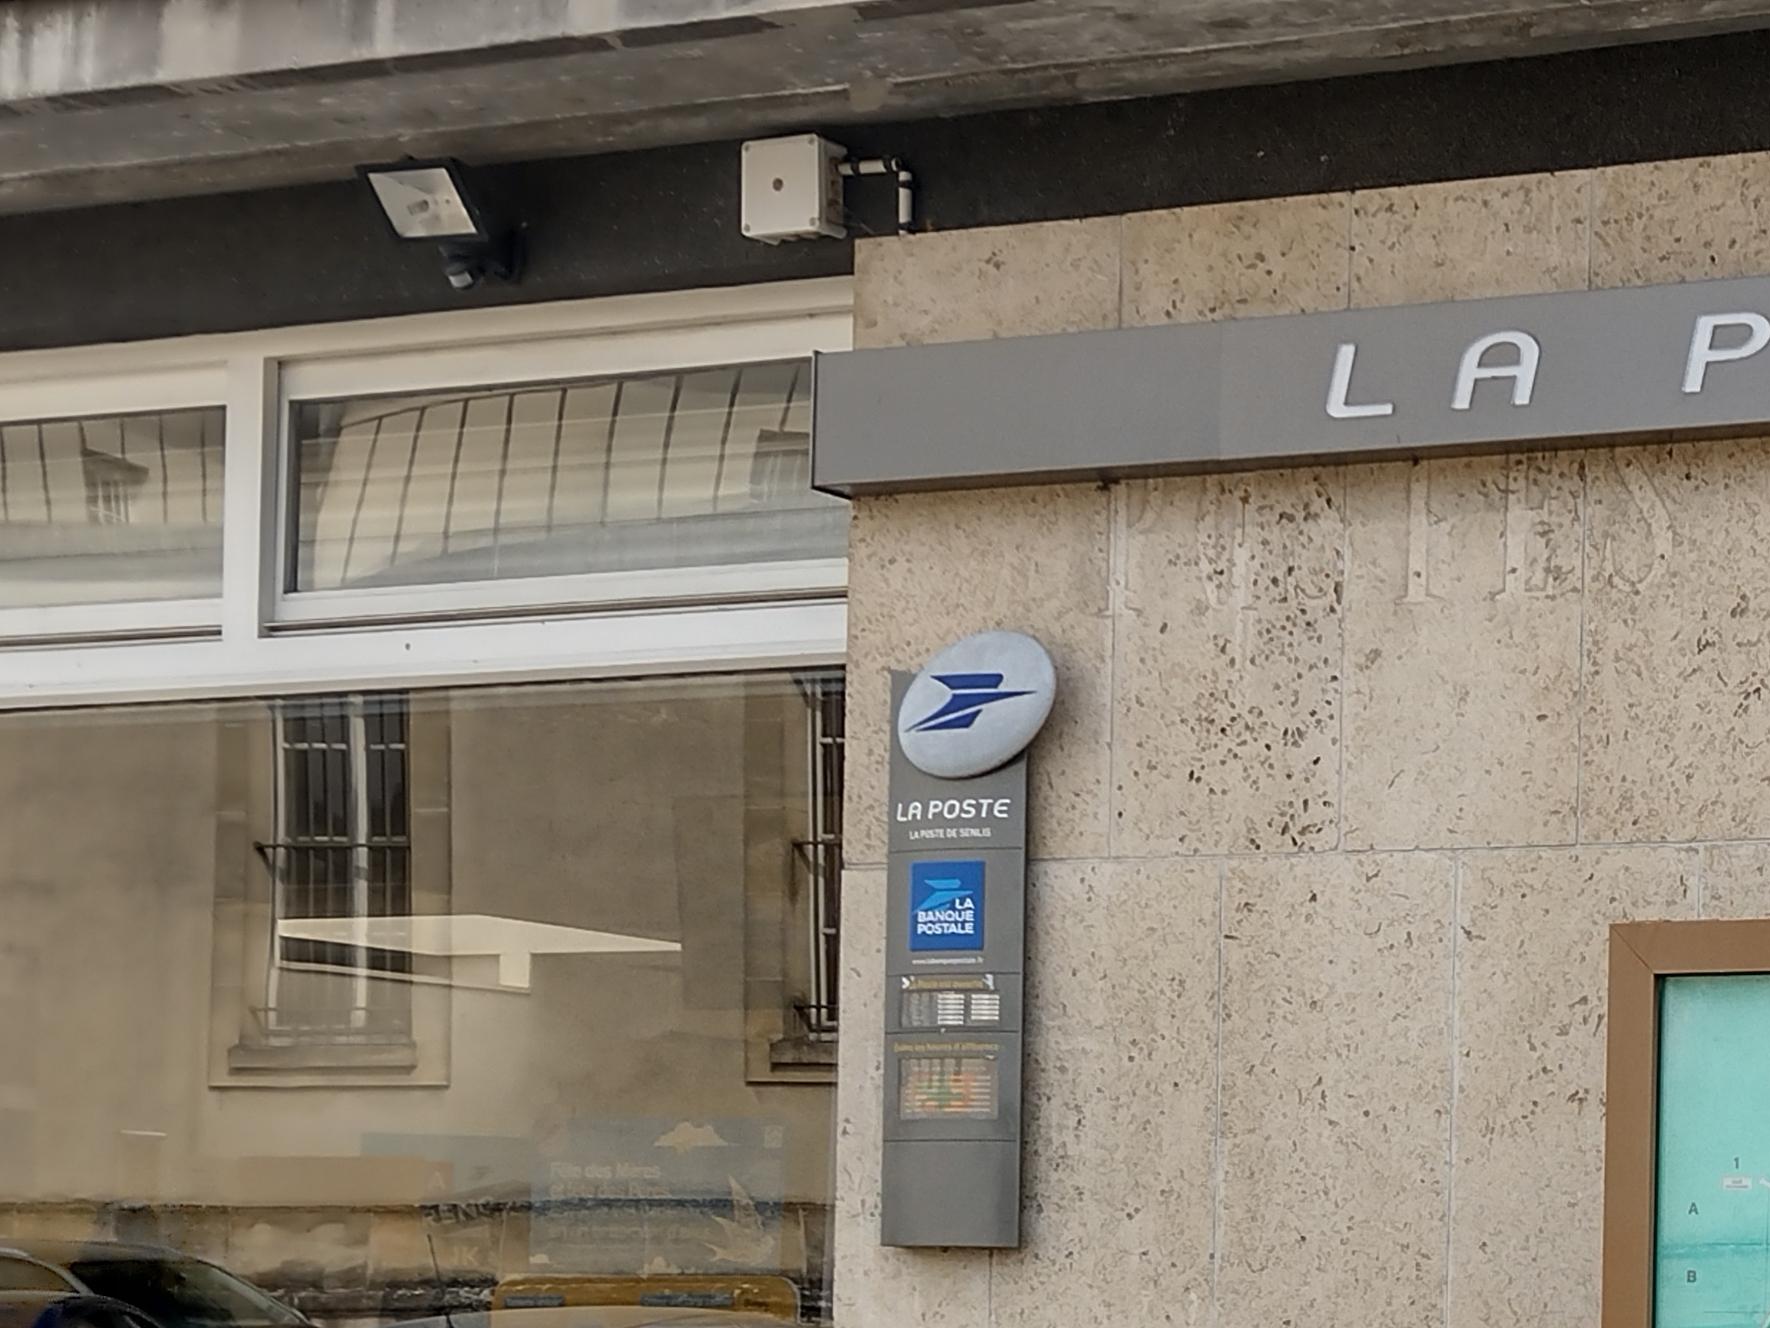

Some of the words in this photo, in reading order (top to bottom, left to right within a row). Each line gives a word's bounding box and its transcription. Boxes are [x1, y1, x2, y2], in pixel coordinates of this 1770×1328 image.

[1324, 329, 1543, 419] LA
[896, 801, 923, 822] LA
[927, 798, 1012, 820] POSTE
[955, 897, 976, 910] LA
[917, 909, 976, 923] BANQUE
[917, 922, 976, 936] POSTALE
[1688, 1202, 1699, 1215] A
[1686, 1269, 1697, 1283] B
